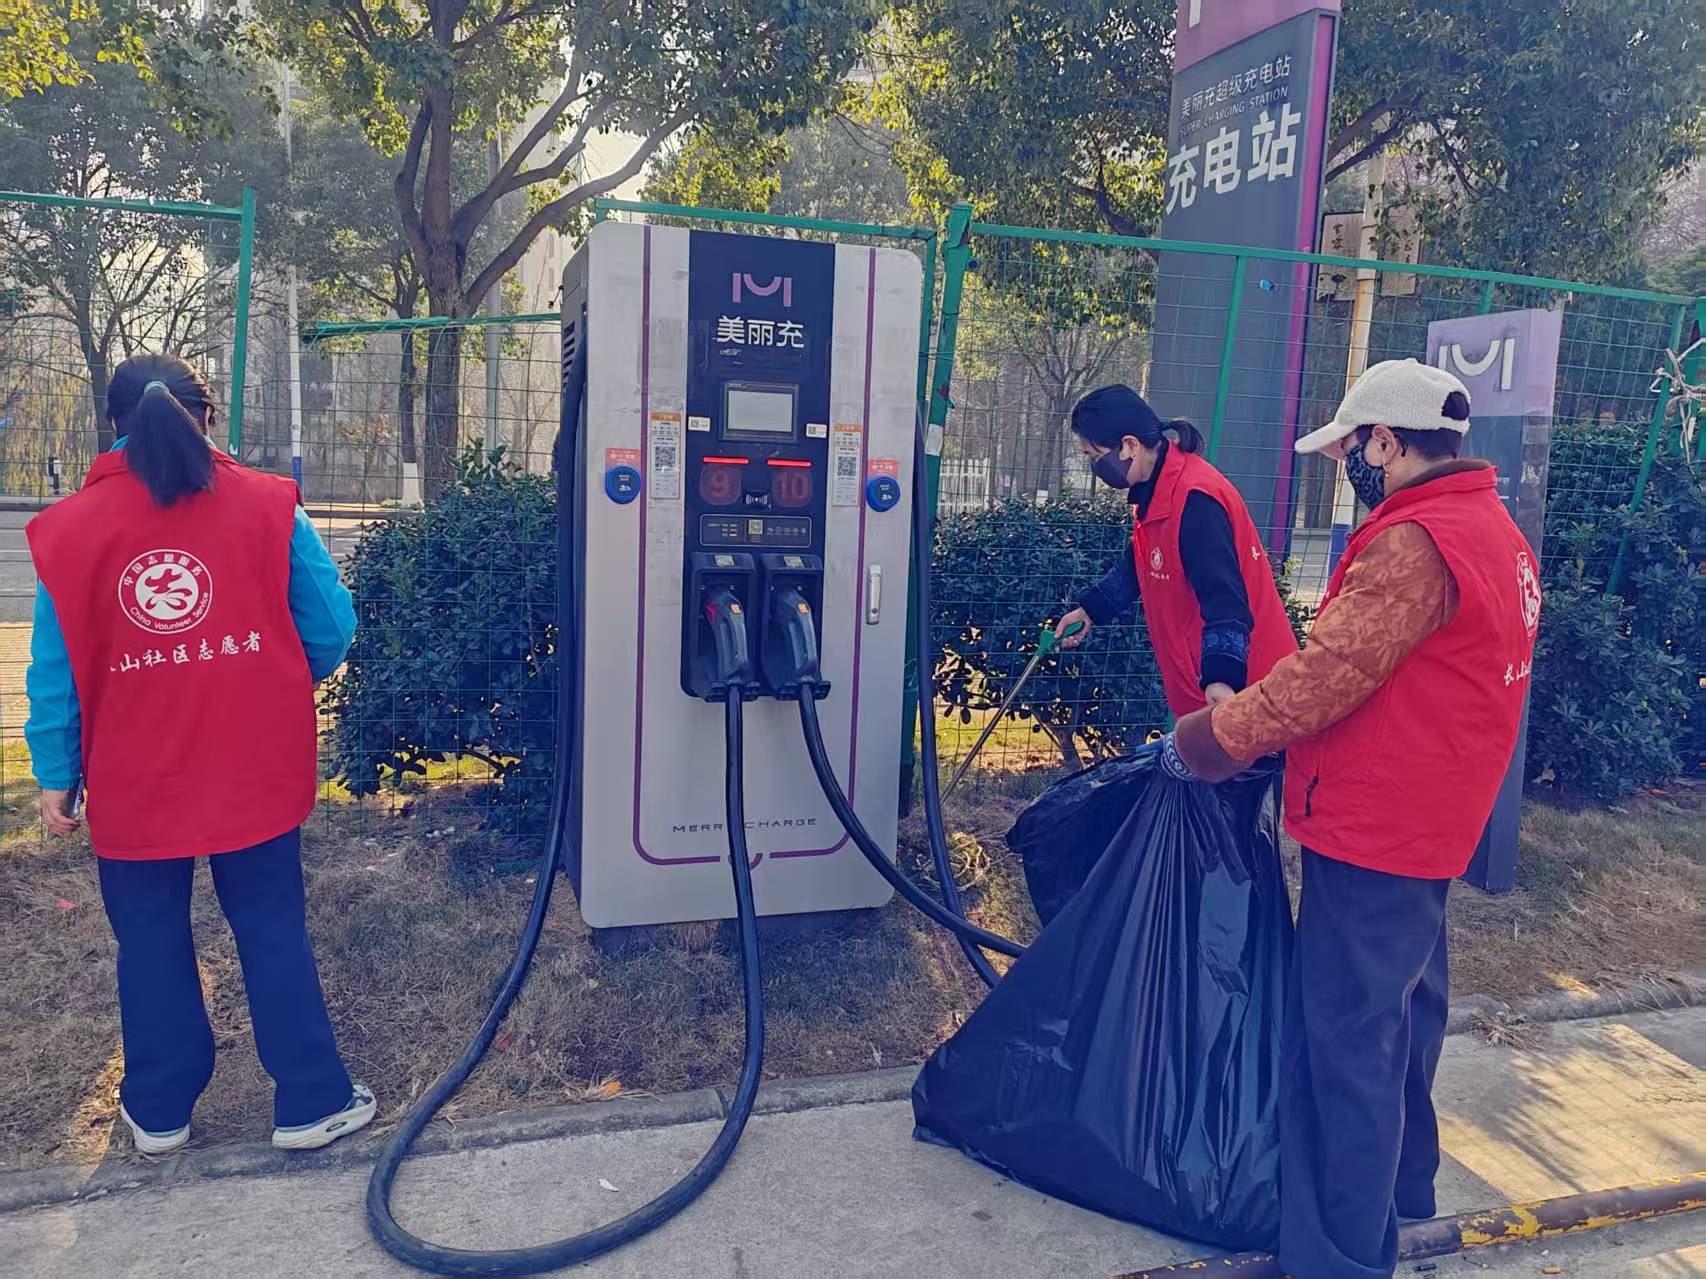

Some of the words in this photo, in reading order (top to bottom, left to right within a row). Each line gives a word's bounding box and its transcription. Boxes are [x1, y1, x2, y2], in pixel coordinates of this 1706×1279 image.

[1179, 117, 1202, 138] SUPER
[1203, 100, 1245, 127] CHARGING
[1249, 86, 1289, 111] STATION
[1165, 103, 1302, 215] 充电站
[716, 315, 805, 349] 美丽充
[130, 607, 151, 627] China
[154, 617, 193, 631] Volunteer
[193, 592, 210, 618] Service
[110, 630, 262, 673] 山社区志愿者
